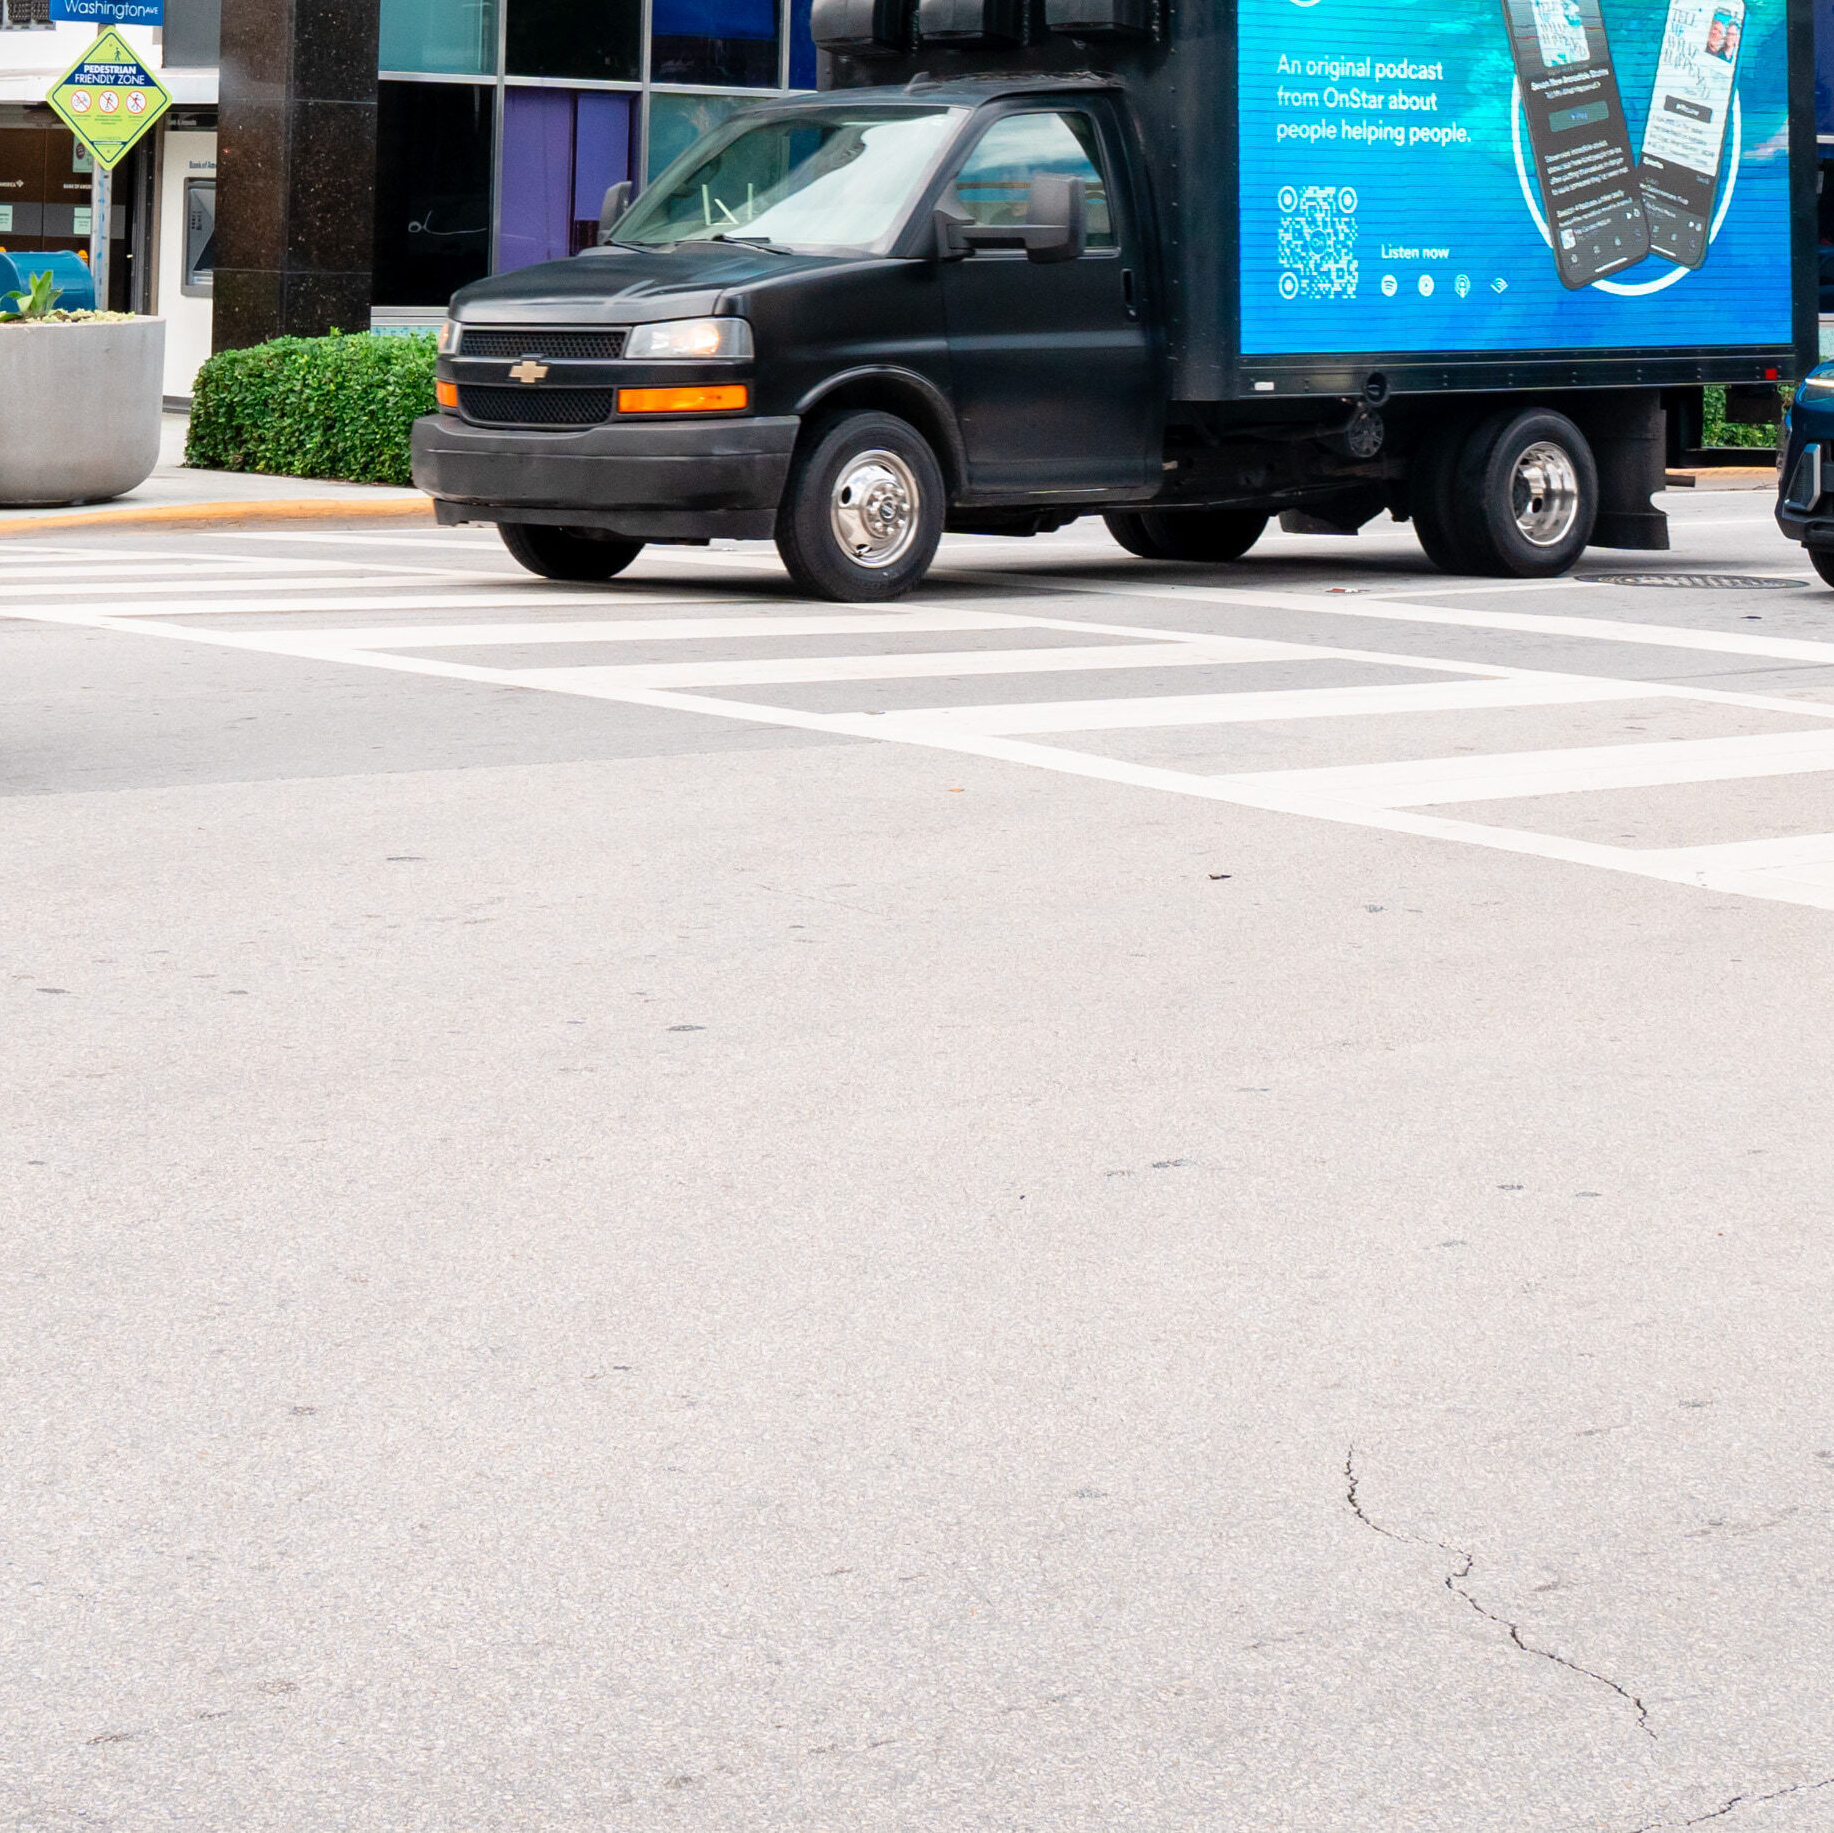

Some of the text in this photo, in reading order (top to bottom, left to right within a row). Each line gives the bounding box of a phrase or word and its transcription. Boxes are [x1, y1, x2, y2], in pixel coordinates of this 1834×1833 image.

[74, 73, 145, 85] FRIENDLY ZONE
[83, 64, 137, 75] PEDESTRIAN
[1277, 54, 1443, 83] An original podcast
[1277, 85, 1438, 111] from OnStar about
[1277, 118, 1471, 147] people helping people.
[1381, 243, 1450, 259] Listen now
